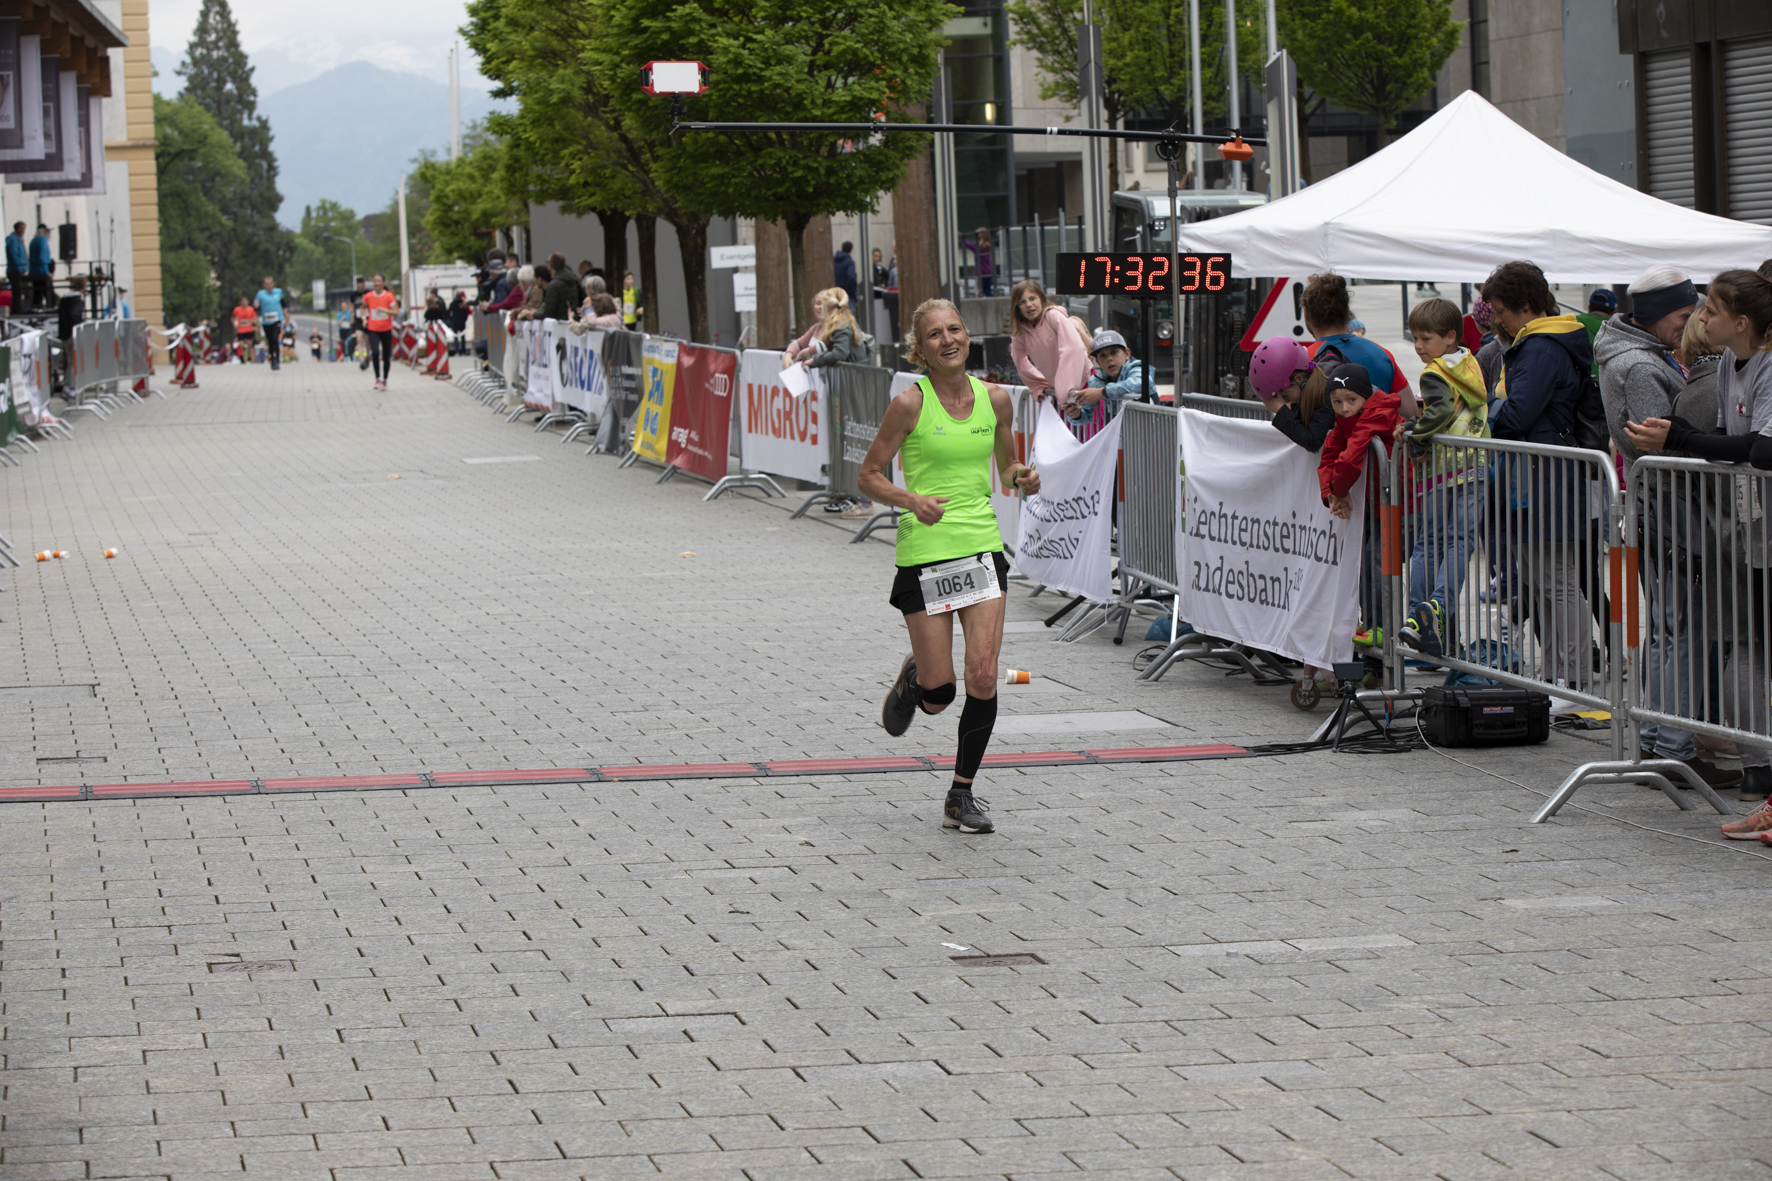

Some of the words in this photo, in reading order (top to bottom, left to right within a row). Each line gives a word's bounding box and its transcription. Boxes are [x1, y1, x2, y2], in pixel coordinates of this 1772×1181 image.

[1181, 256, 1226, 291] 36
[1095, 336, 1113, 347] VANS
[747, 382, 819, 446] MIGROS
[934, 572, 976, 598] 1064
[1191, 555, 1293, 612] andesbank
